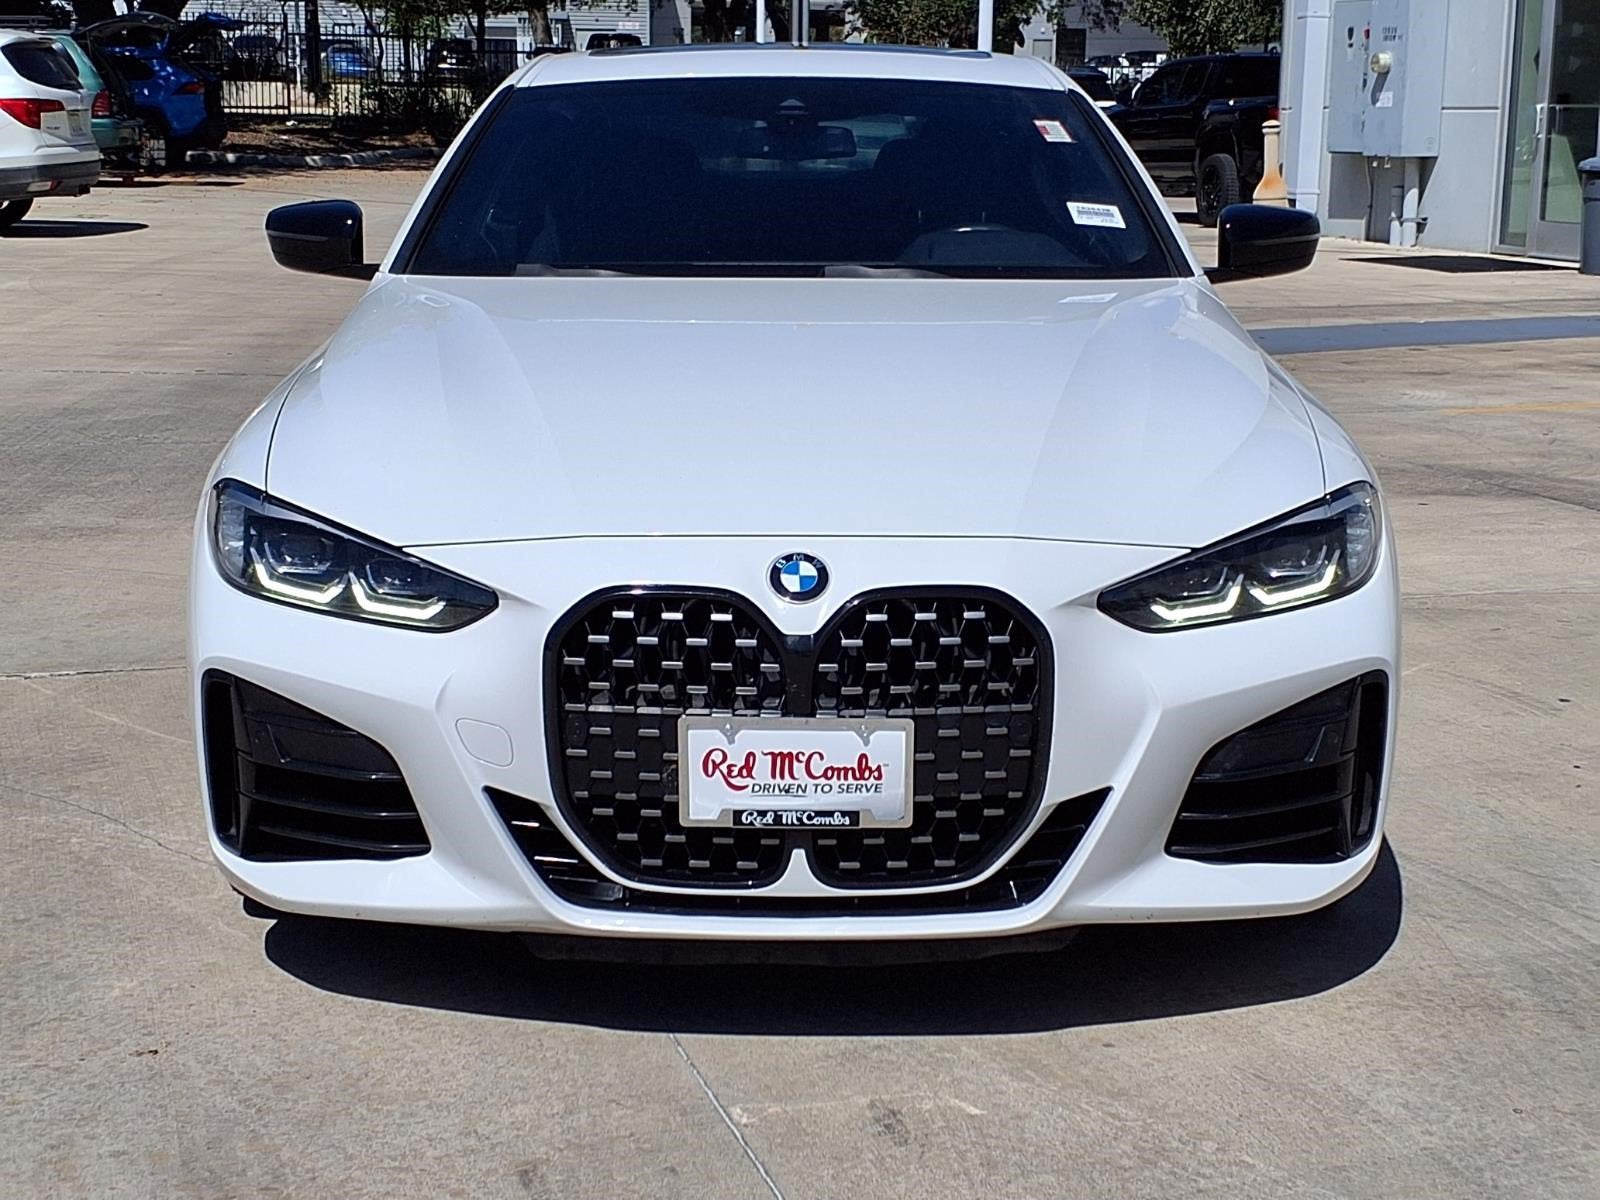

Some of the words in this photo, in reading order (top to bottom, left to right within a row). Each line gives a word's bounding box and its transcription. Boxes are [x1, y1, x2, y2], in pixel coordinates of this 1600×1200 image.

[775, 553, 825, 569] BMW
[702, 747, 757, 792] Red
[761, 751, 884, 781] McCombs
[751, 783, 808, 794] DRIVEN
[813, 783, 833, 794] TO
[837, 783, 884, 794] SERVE
[741, 810, 774, 826] Red
[777, 810, 851, 826] McCombs
